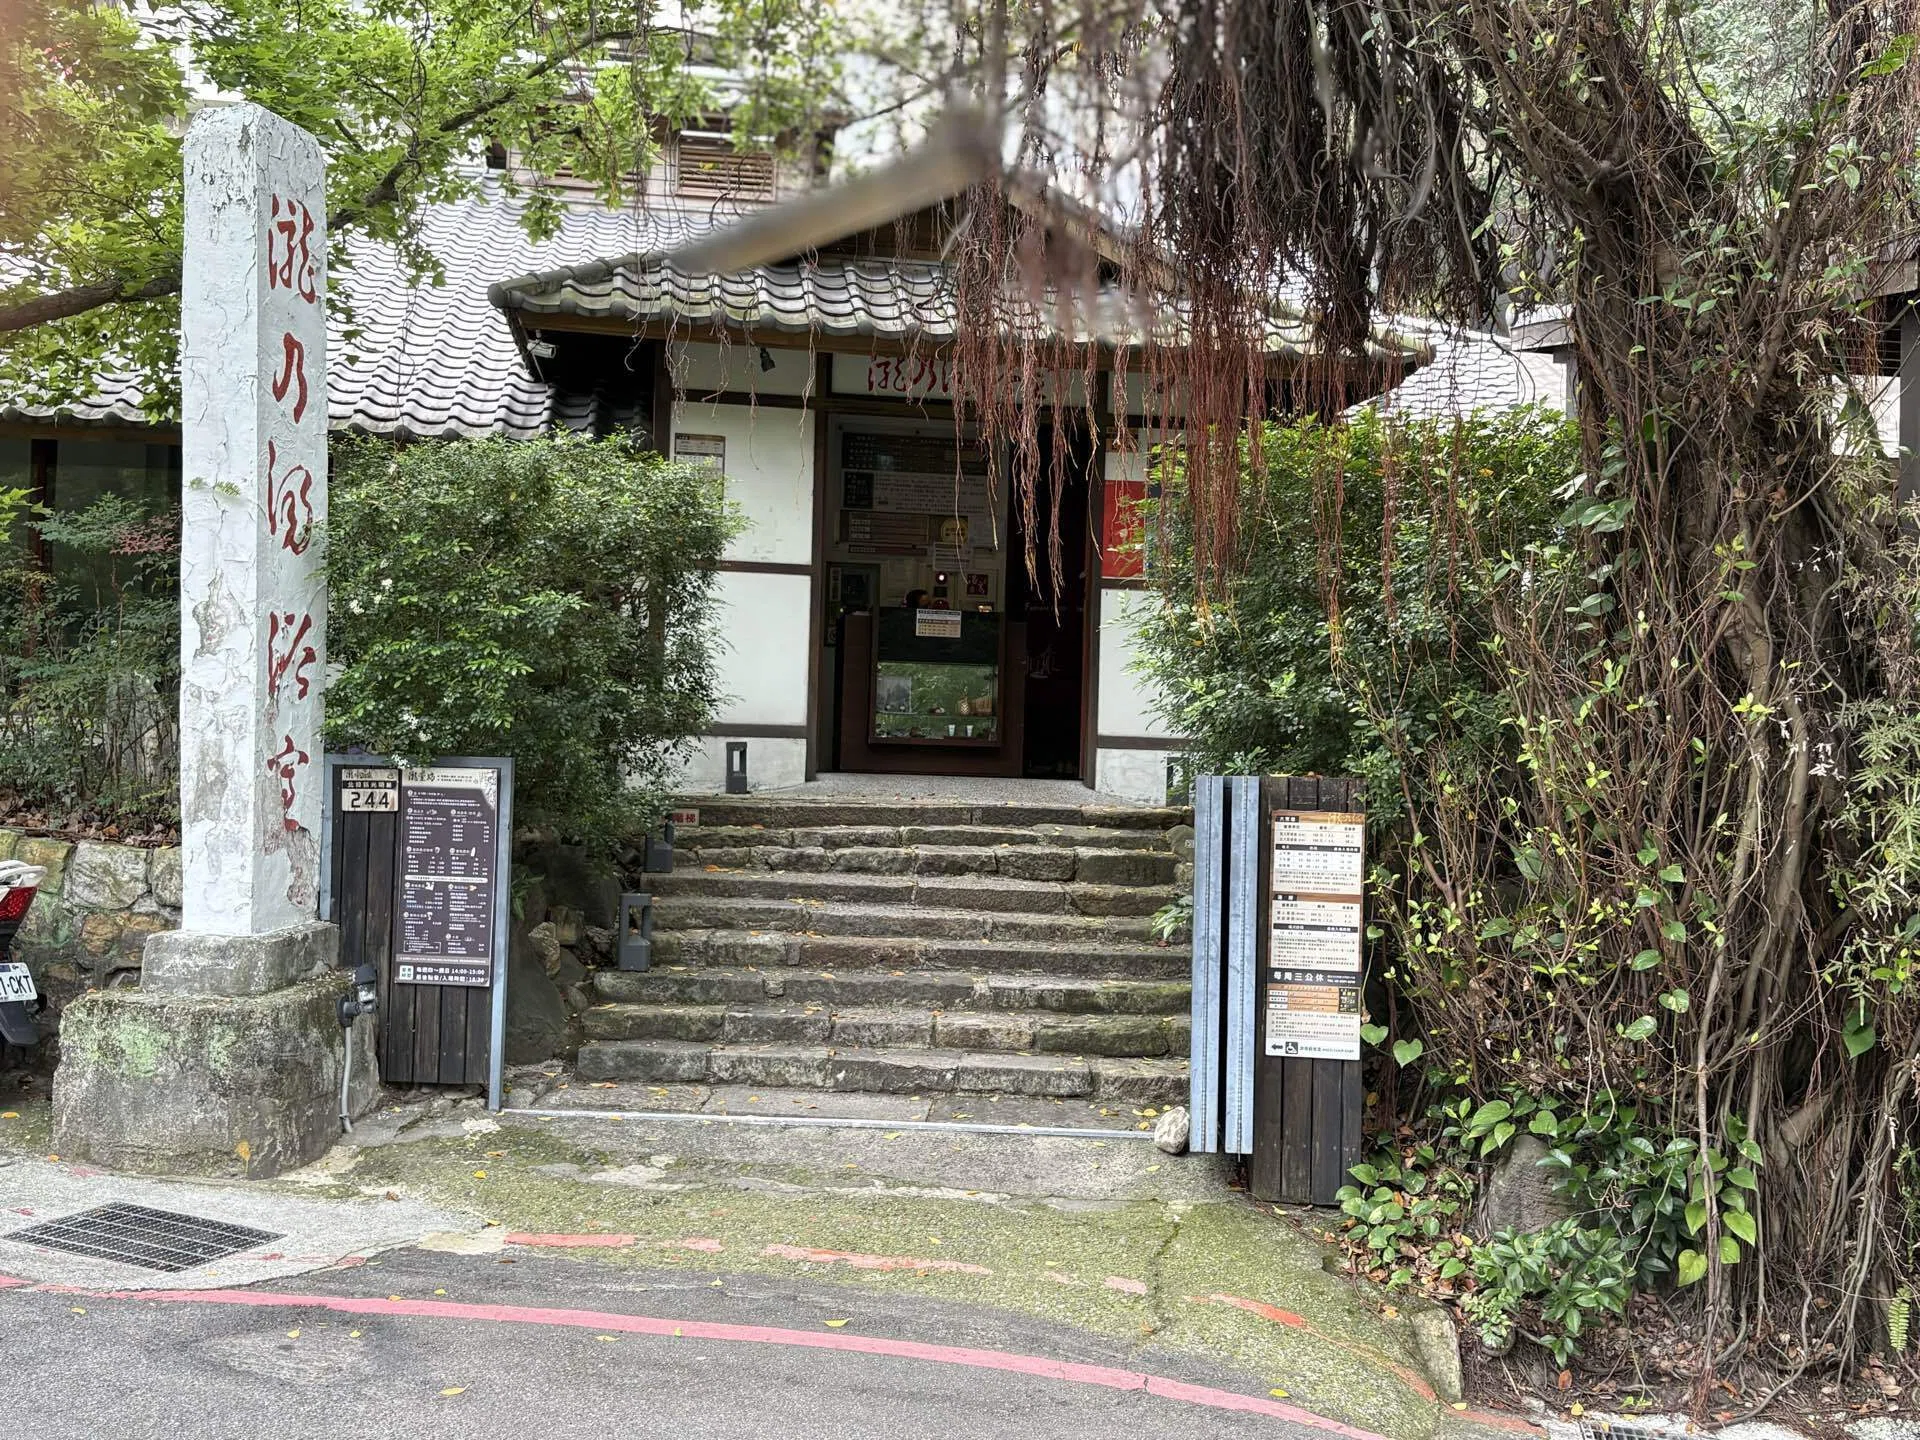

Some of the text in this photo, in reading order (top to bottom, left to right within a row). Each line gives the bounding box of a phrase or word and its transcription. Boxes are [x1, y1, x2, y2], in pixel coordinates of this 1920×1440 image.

[351, 791, 390, 809] 244
[0, 975, 32, 995] 1-CKT
[1274, 971, 1324, 982] 每周三公休
